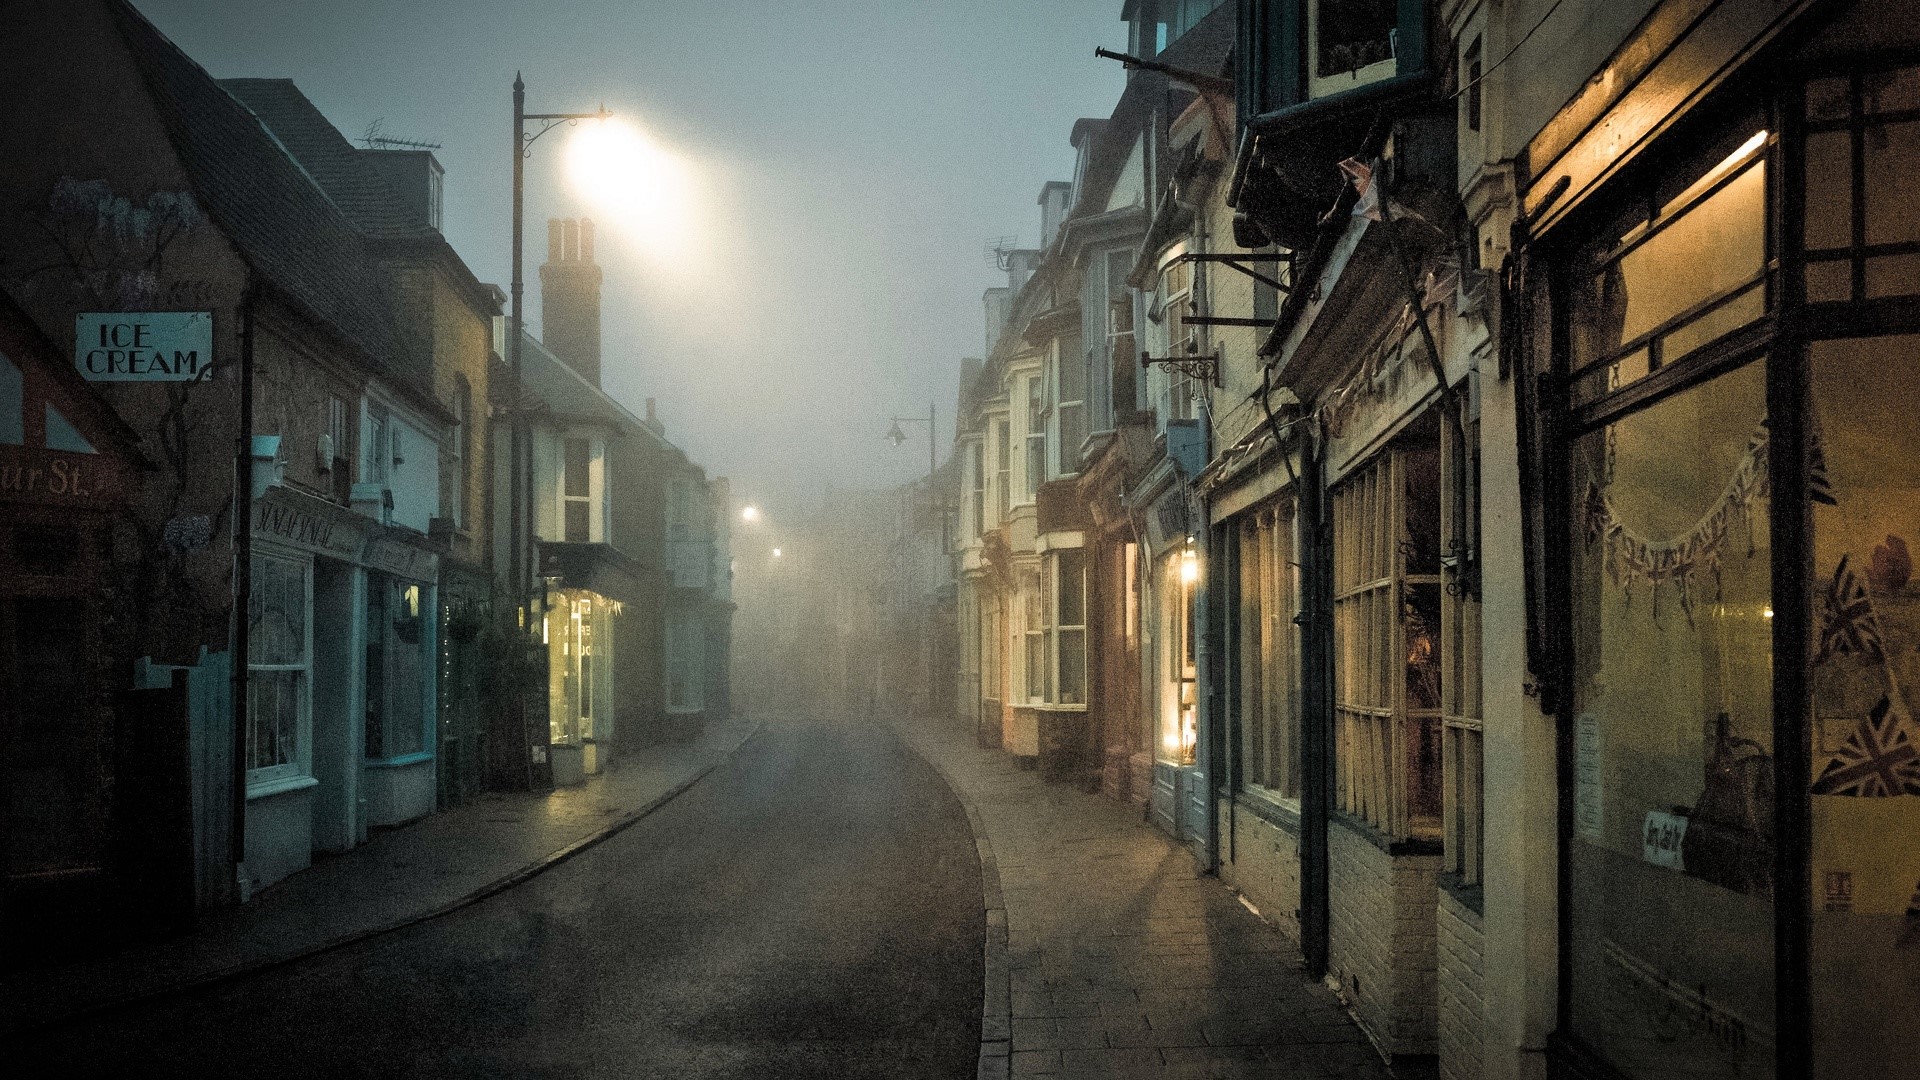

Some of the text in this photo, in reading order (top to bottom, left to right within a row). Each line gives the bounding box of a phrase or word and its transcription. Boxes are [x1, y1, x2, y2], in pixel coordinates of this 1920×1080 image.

[100, 323, 153, 348] ICE
[86, 350, 198, 374] CREAM
[48, 458, 89, 497] St.
